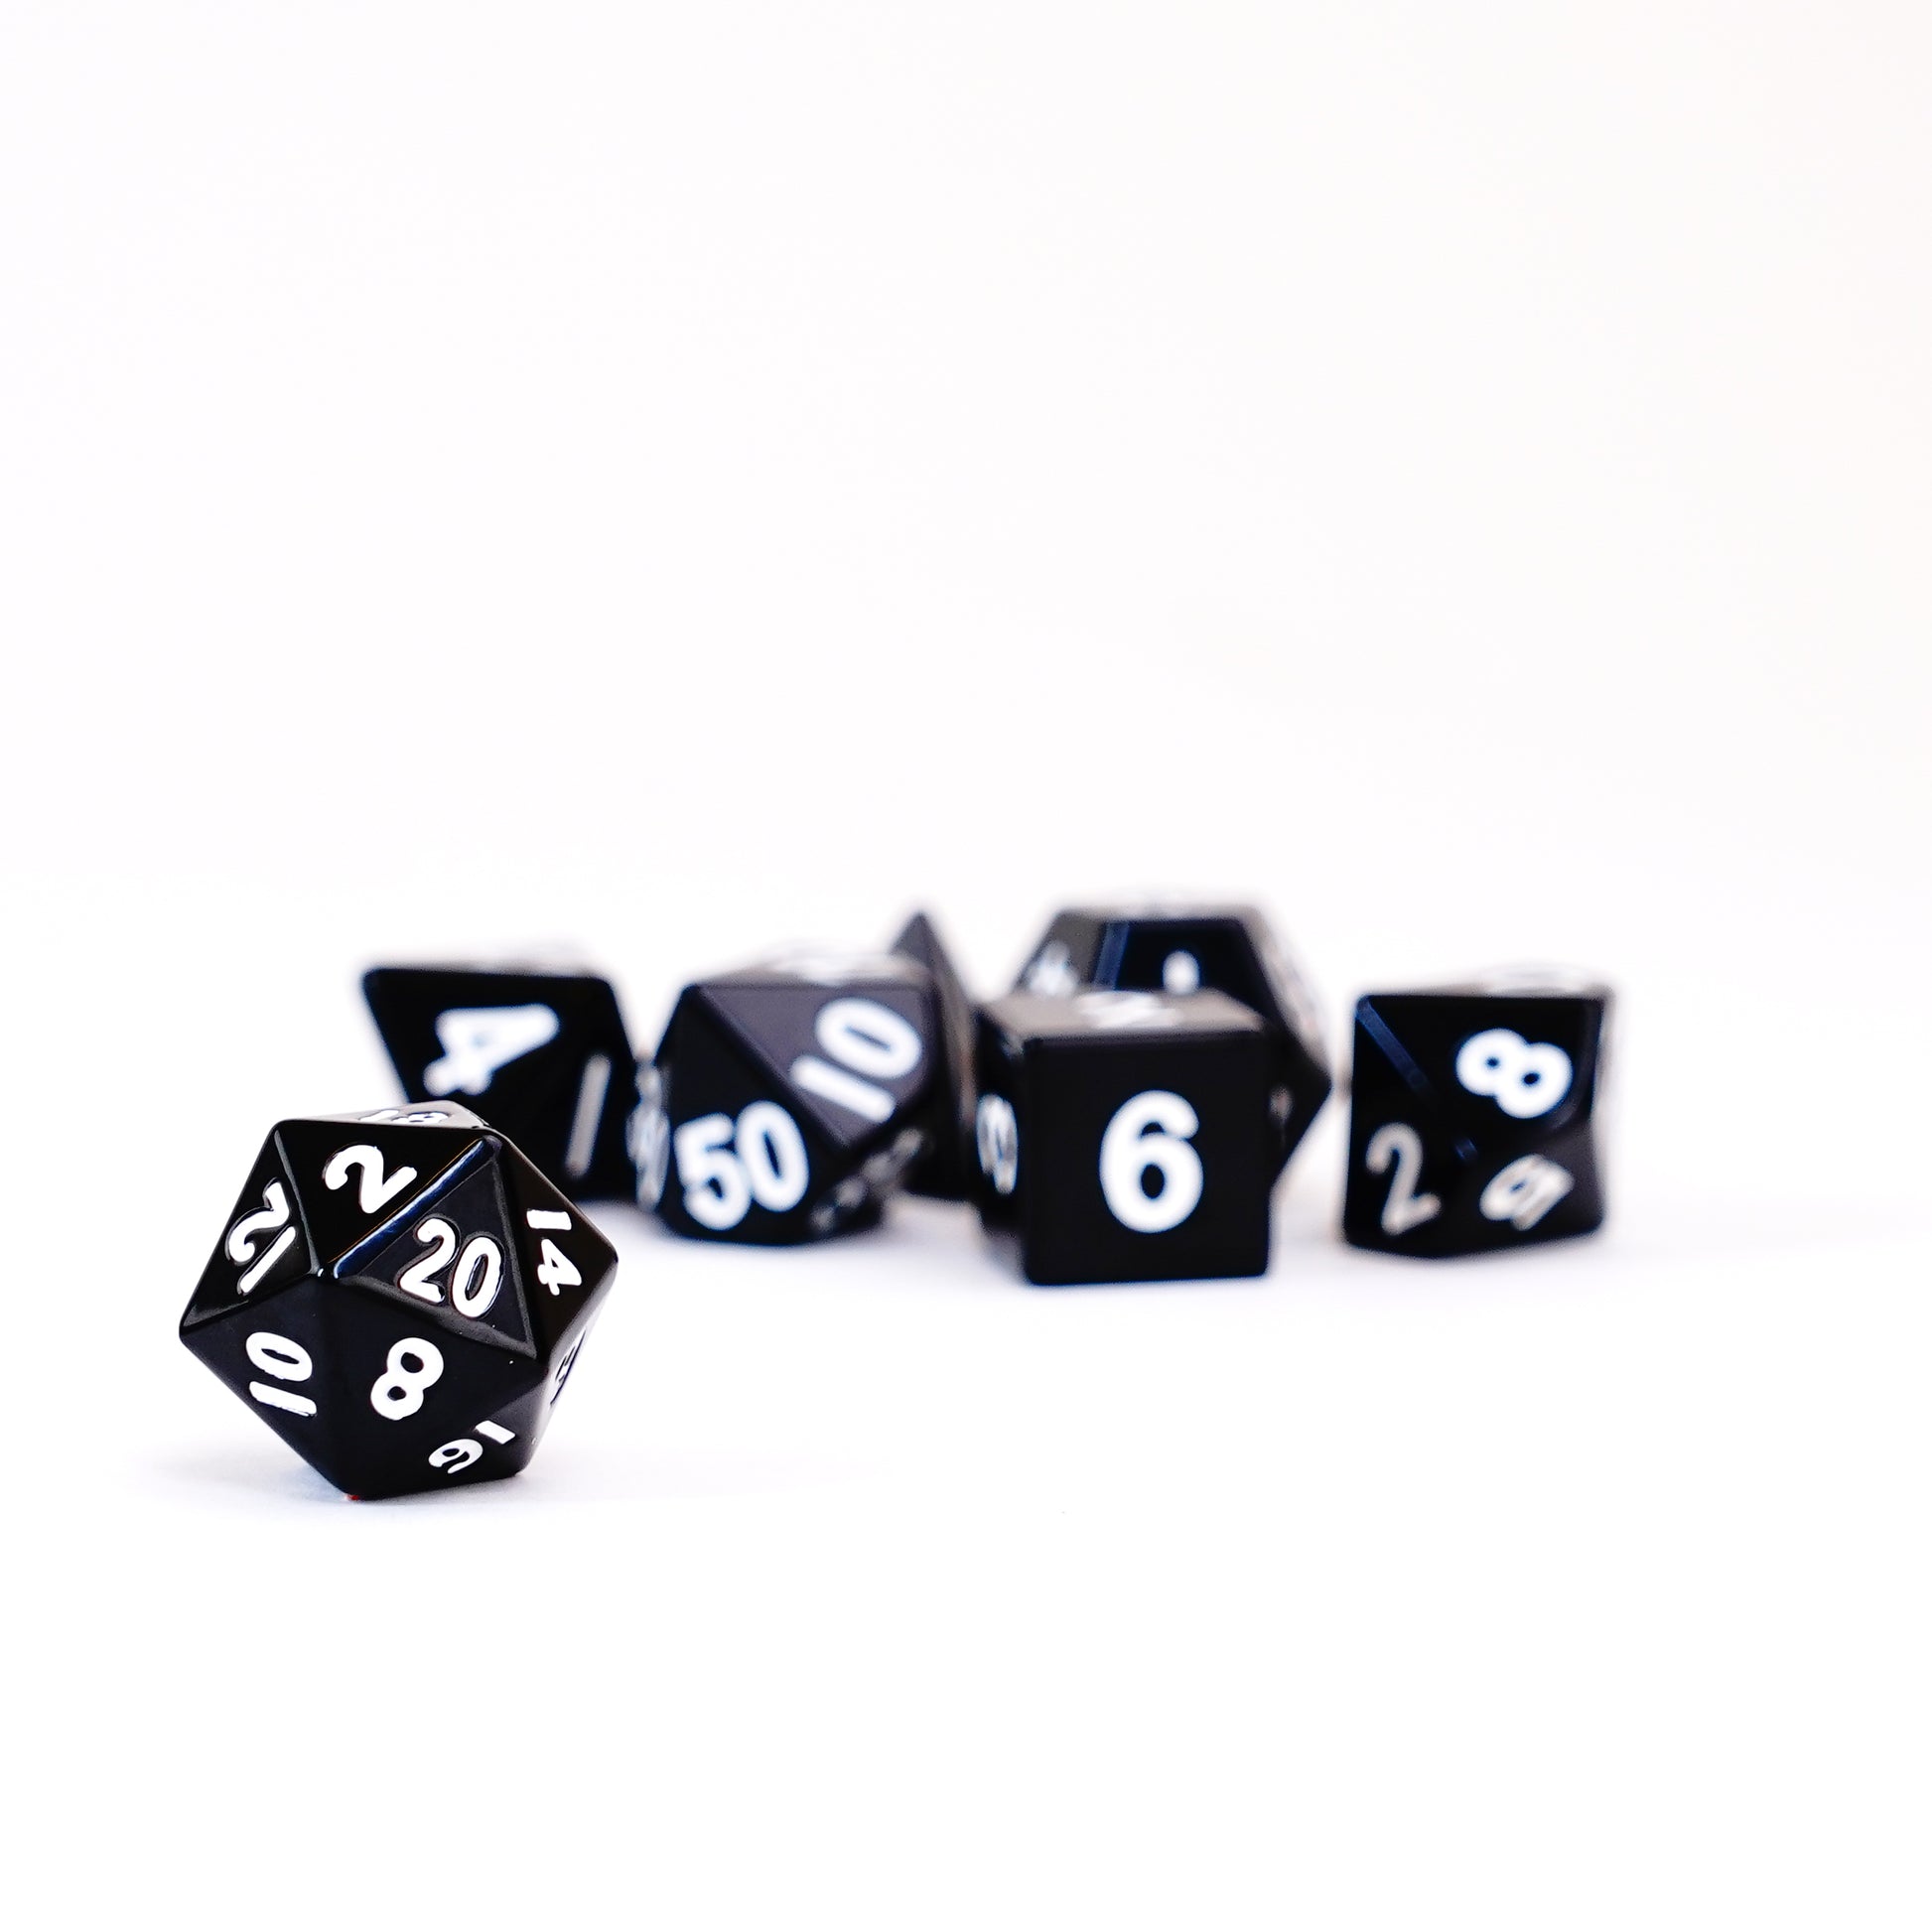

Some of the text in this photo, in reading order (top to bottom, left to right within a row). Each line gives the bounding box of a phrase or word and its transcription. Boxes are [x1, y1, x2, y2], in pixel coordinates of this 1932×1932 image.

[425, 1005, 559, 1096] 4
[790, 999, 923, 1123] 10
[1455, 1028, 1574, 1119] 8
[324, 1144, 418, 1214] 2
[678, 1102, 809, 1228] 50
[1099, 1090, 1204, 1234] 6
[1365, 1123, 1442, 1236] 2
[226, 1180, 298, 1296] 12
[399, 1217, 504, 1319] 20
[526, 1208, 583, 1298] 14
[245, 1331, 318, 1417] 10
[370, 1337, 445, 1421] 8
